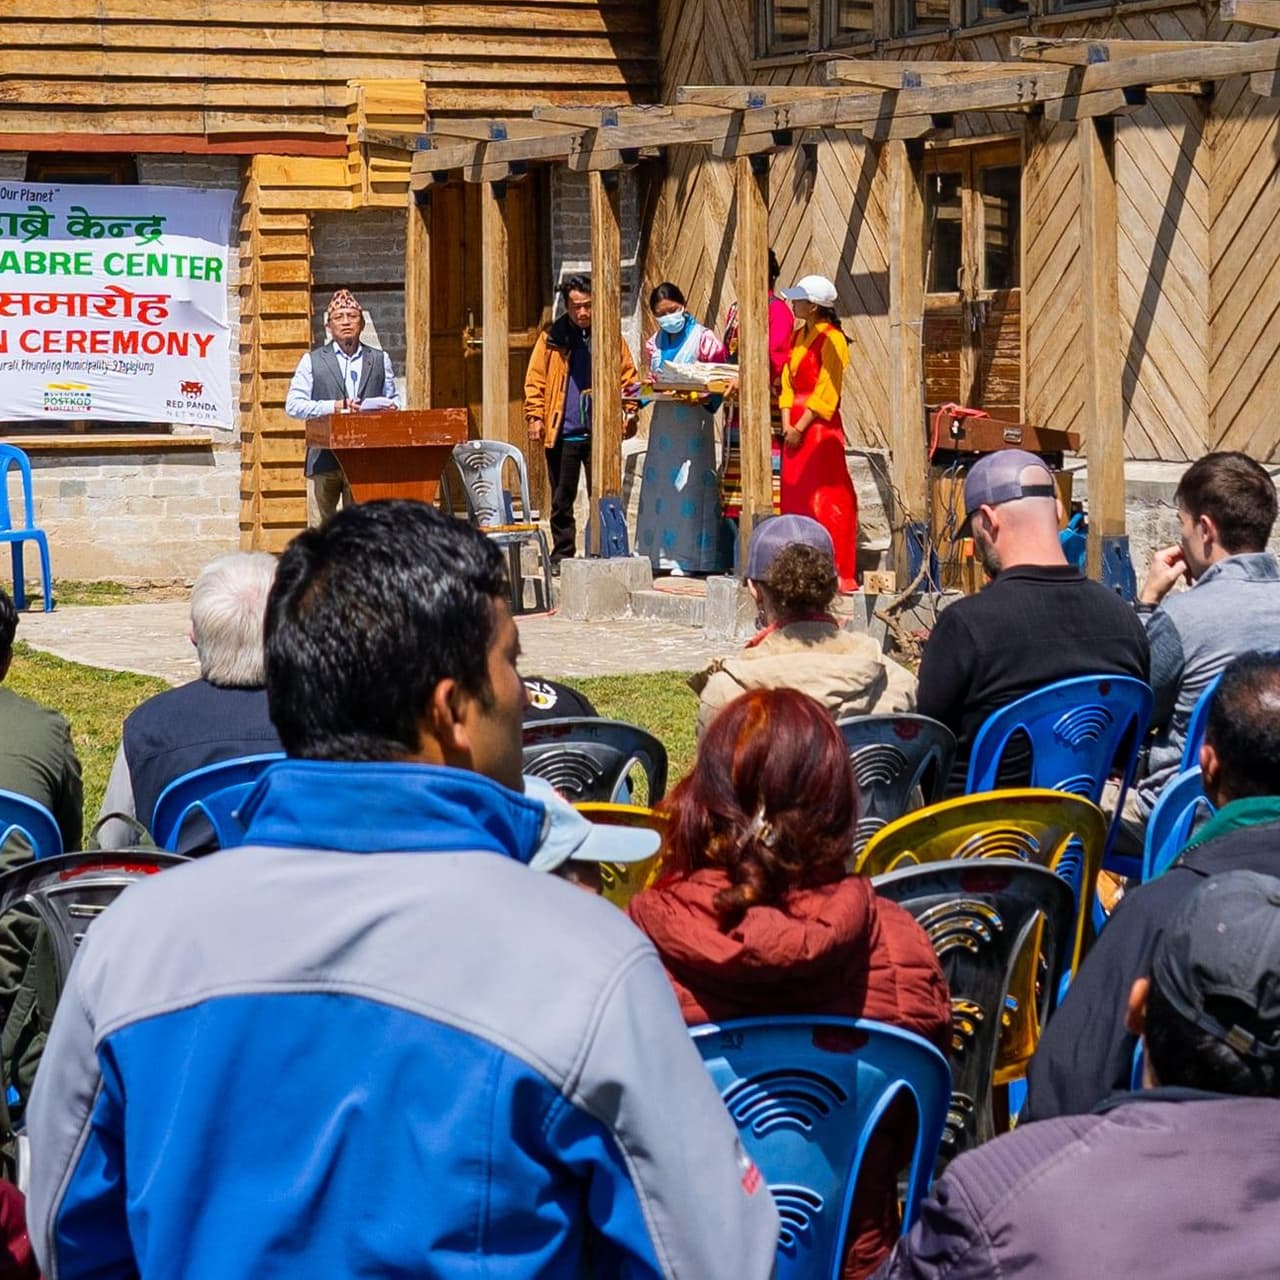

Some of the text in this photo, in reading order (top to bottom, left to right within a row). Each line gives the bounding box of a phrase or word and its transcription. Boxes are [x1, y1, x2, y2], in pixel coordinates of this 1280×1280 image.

[0, 186, 19, 200] Our
[66, 206, 167, 246] केन्द्र
[103, 252, 223, 282] CENTER
[20, 330, 215, 358] CEREMONY
[44, 397, 91, 406] POSTKOD
[166, 399, 217, 412] RED PANDA
